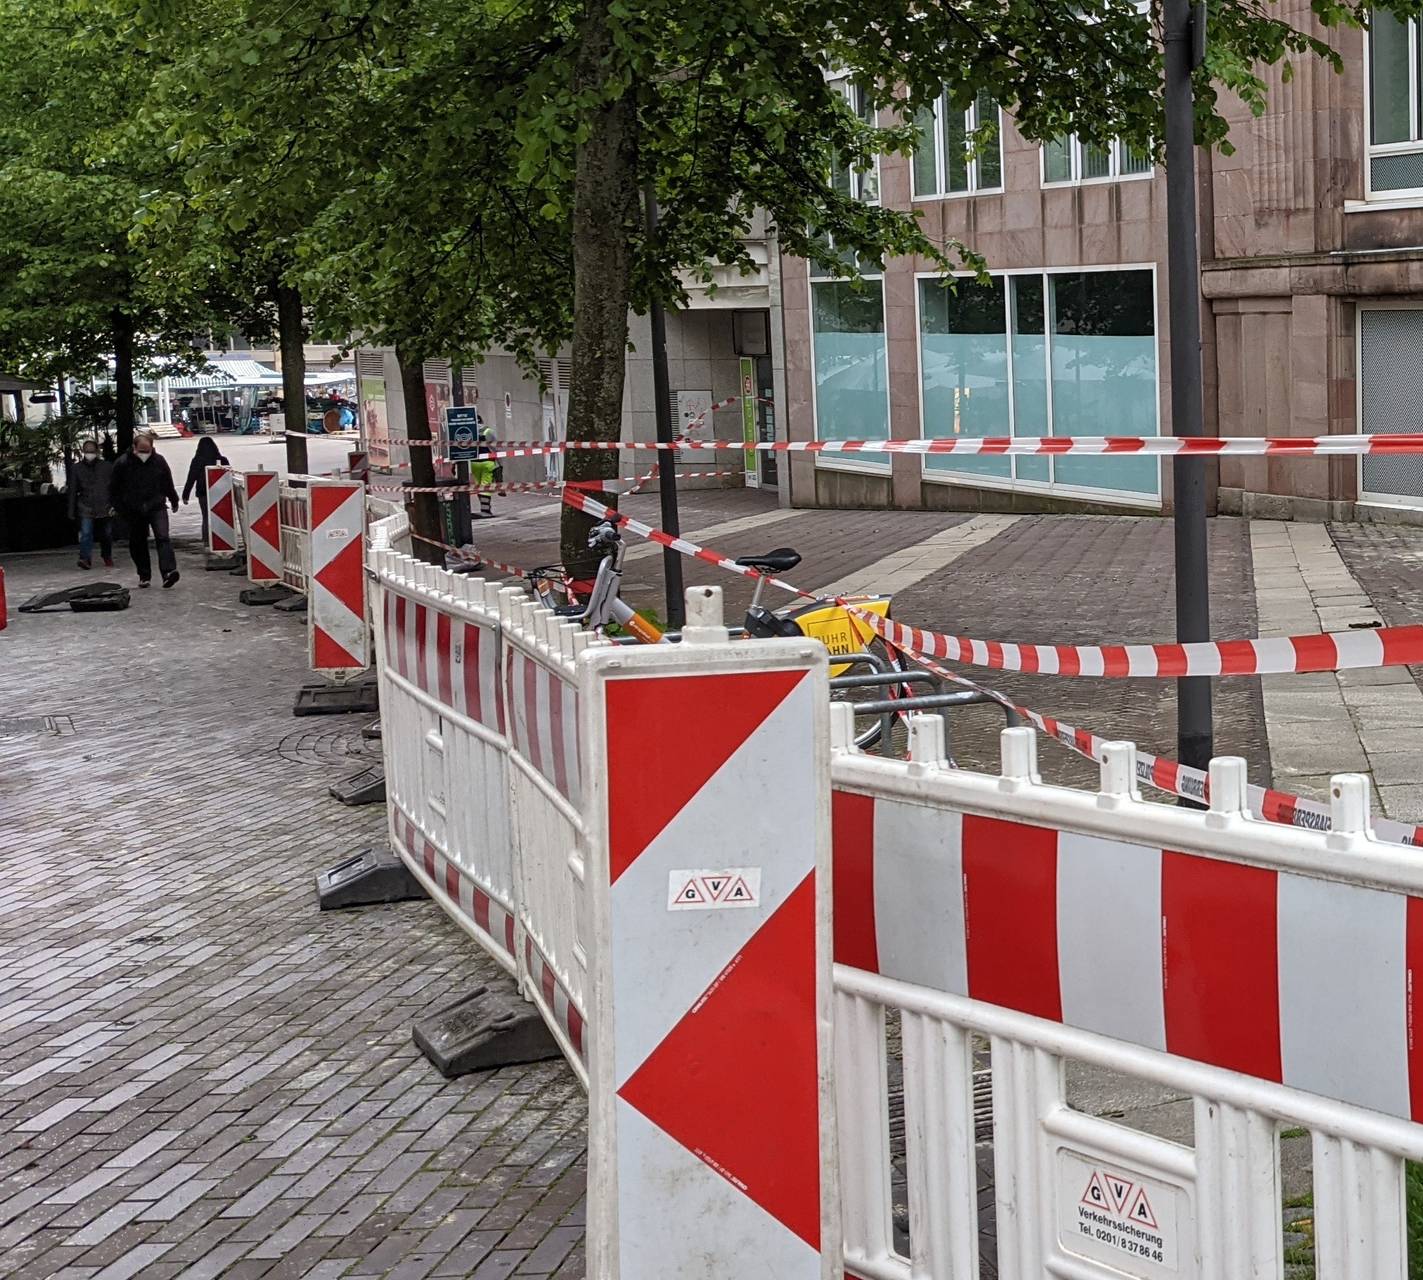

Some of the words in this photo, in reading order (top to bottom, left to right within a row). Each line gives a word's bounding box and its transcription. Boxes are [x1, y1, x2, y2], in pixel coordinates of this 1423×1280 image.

[814, 631, 847, 646] UHR
[1078, 1205, 1163, 1249] Verkehrssicherung
[1078, 1221, 1094, 1237] Tel.
